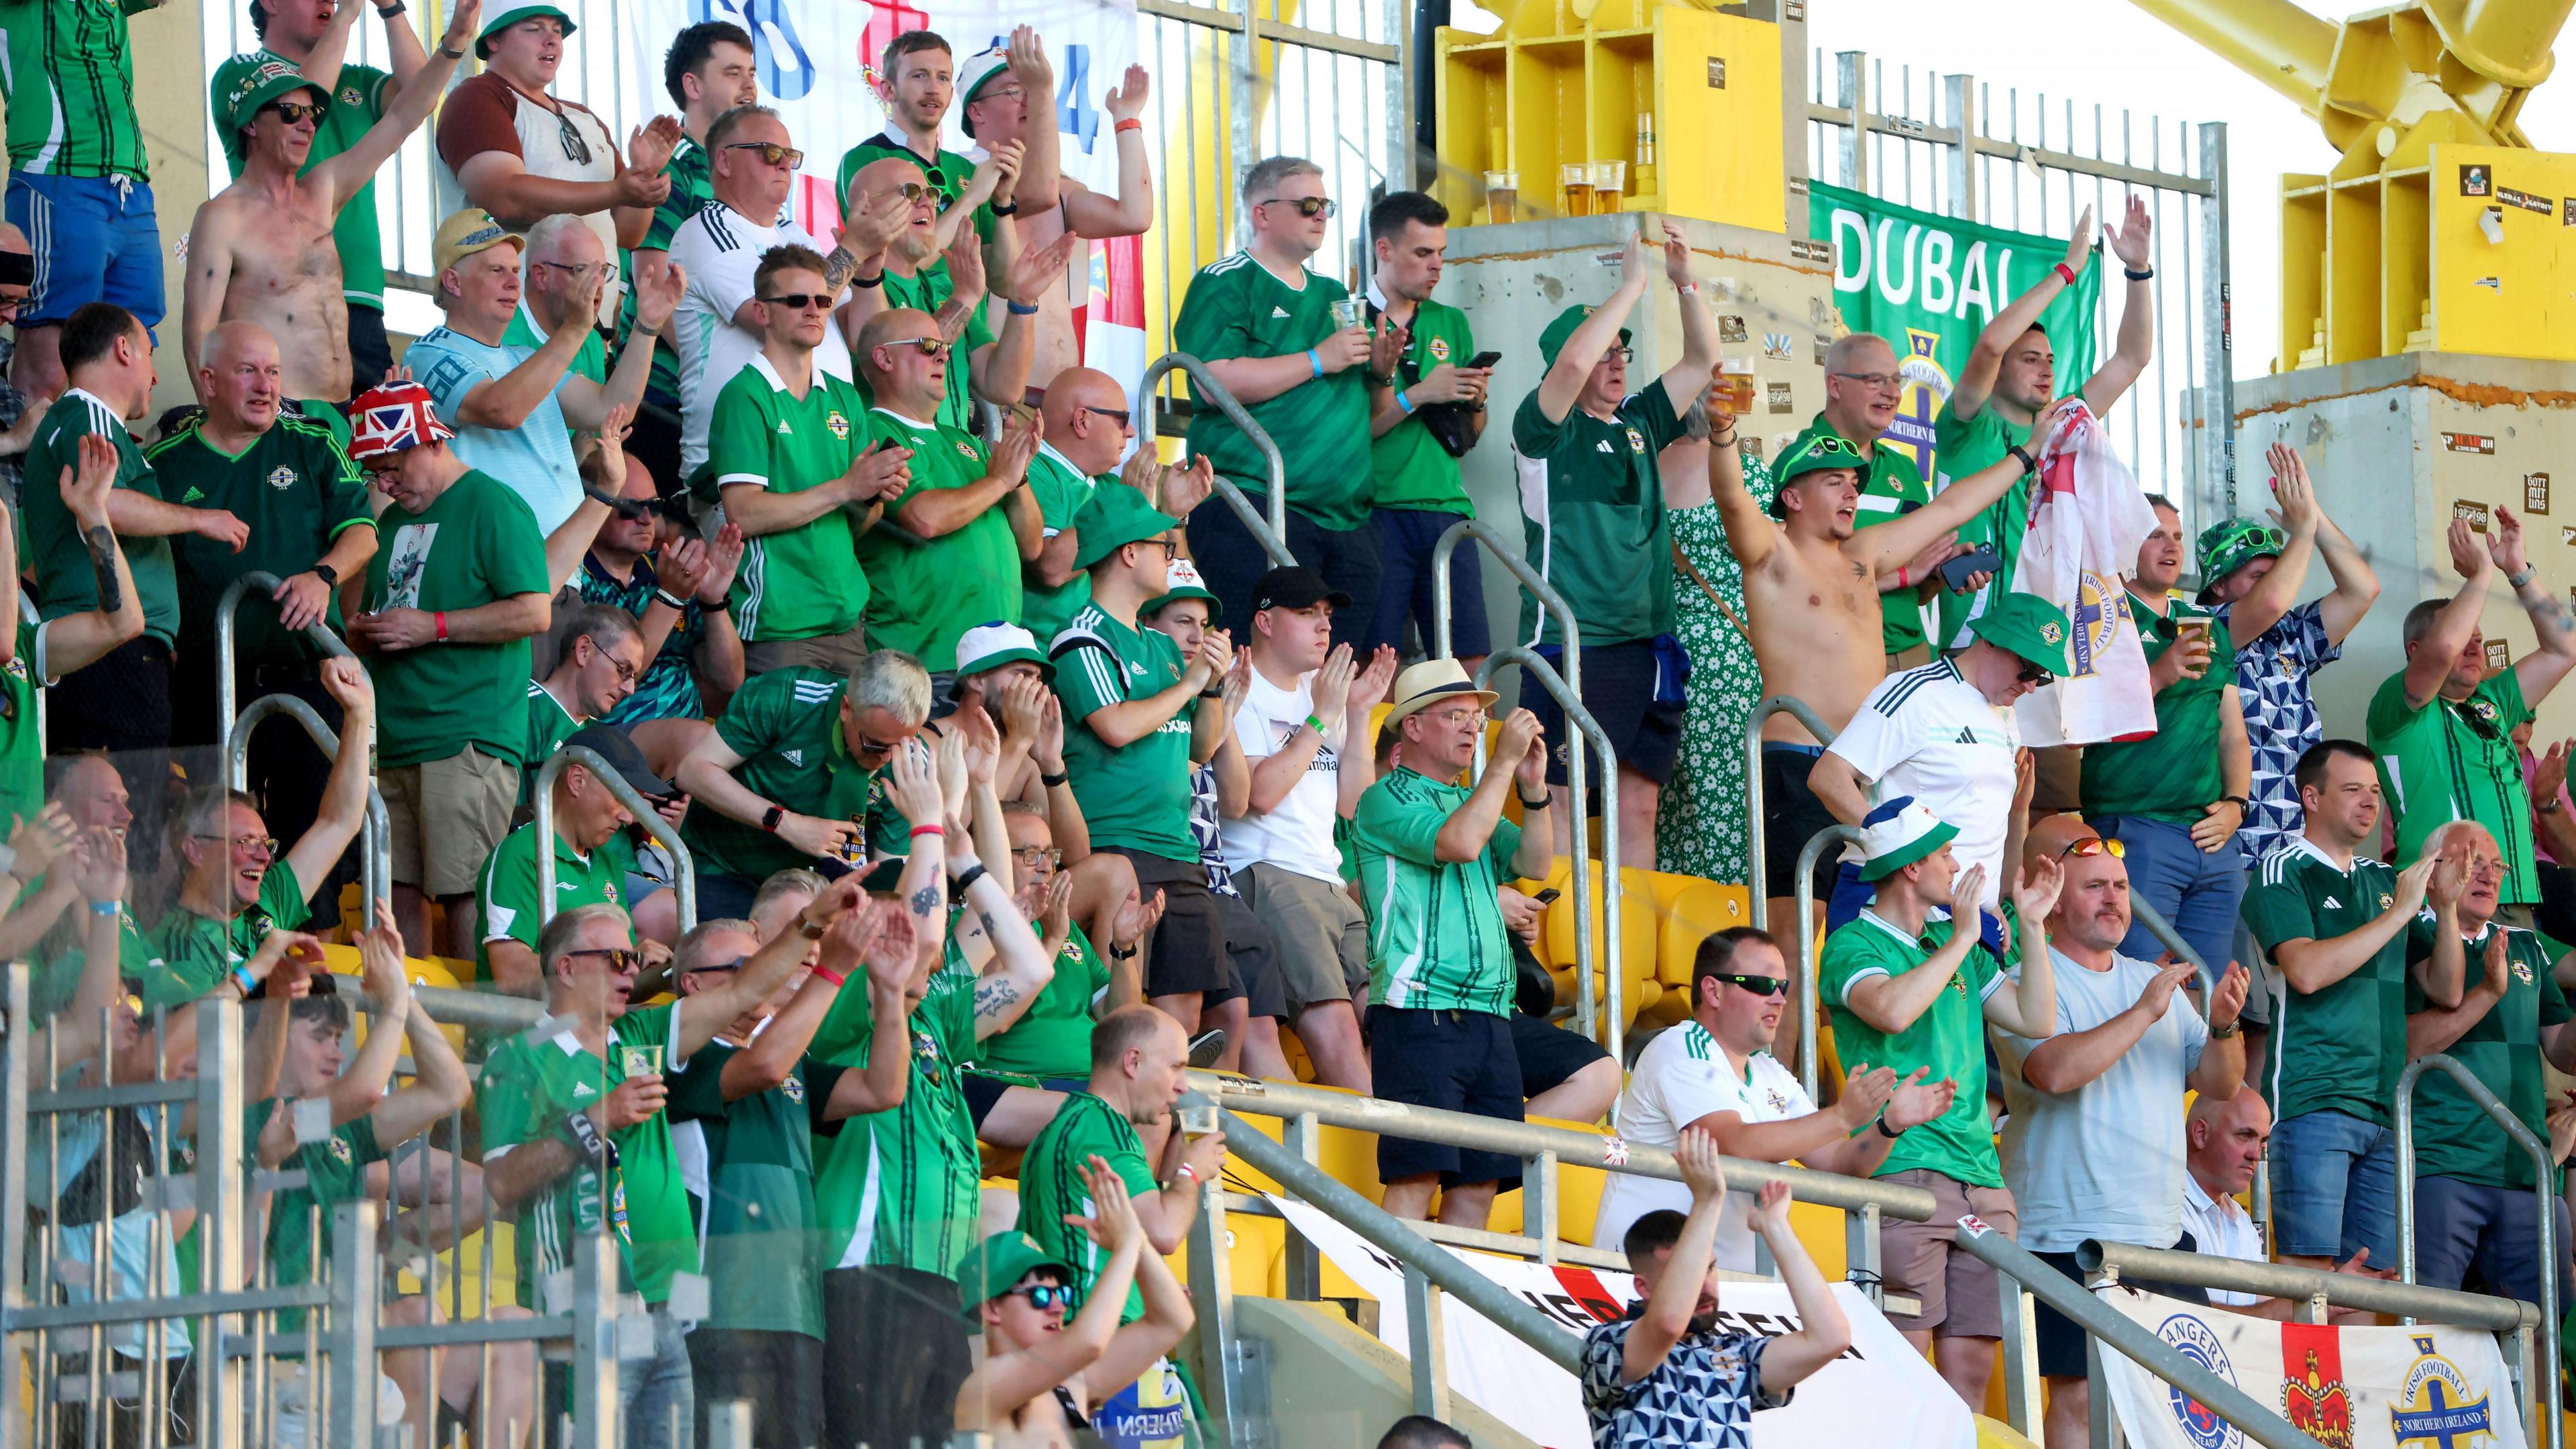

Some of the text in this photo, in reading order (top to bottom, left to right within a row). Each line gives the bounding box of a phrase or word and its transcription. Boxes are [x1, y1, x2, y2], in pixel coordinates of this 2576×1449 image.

[1831, 208, 2012, 326] DUBAI
[1768, 392, 1791, 402] 19 98
[2528, 477, 2547, 488] GOTT
[2528, 487, 2546, 499] MIT
[2454, 507, 2463, 519] 19
[2476, 511, 2487, 523] 98
[2084, 576, 2114, 649] IRISH FOOTBALL
[2076, 623, 2088, 663] IRELAND
[2487, 645, 2506, 655] GOTT
[2489, 655, 2507, 667] MIT
[782, 752, 802, 767] adidas
[1307, 757, 1337, 771] mbia
[2165, 1321, 2226, 1375] ANGERS
[2406, 1361, 2465, 1403] IRISH FOOTBALL
[2403, 1411, 2481, 1432] NORTHERN IRELAND
[2195, 1433, 2218, 1448] READY
